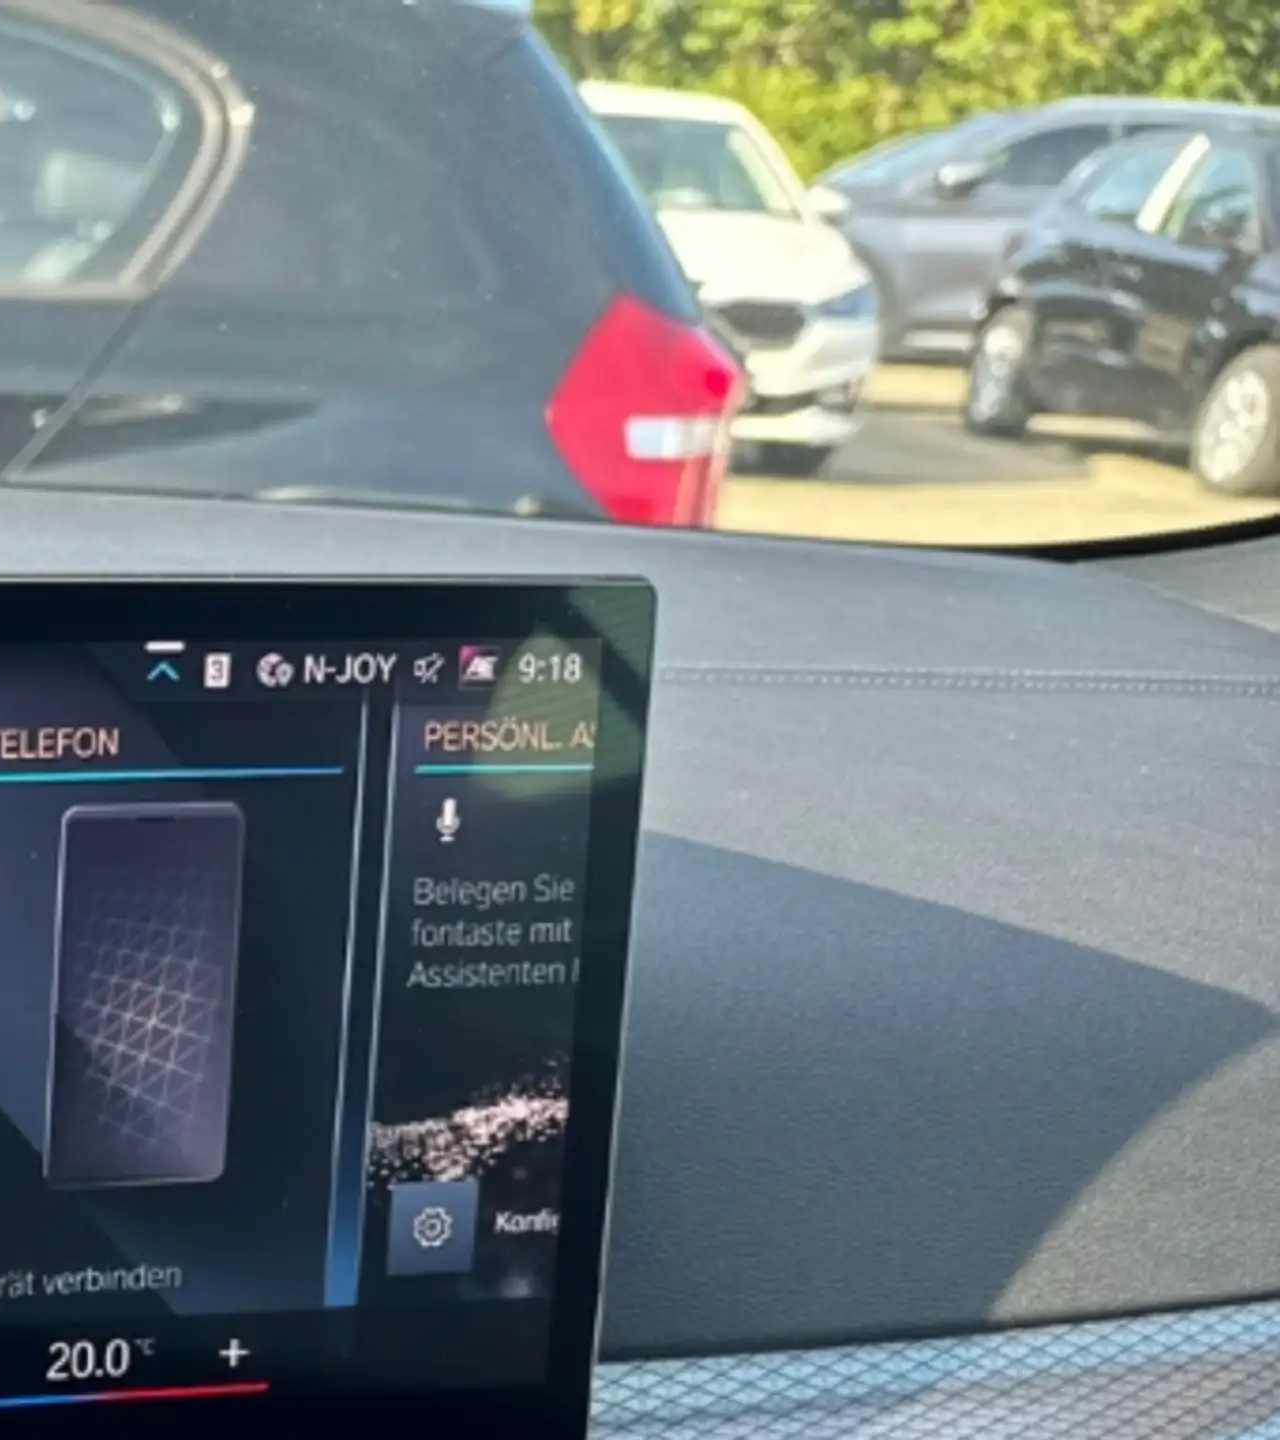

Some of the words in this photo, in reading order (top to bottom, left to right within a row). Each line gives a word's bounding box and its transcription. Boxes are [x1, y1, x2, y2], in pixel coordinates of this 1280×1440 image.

[303, 652, 397, 684] N-JOY
[519, 652, 582, 684] 9:18
[424, 717, 562, 751] PERSÖNL.
[412, 876, 527, 911] Belegen
[534, 873, 576, 902] Sie
[412, 918, 522, 947] fontaste
[530, 917, 573, 944] mit
[406, 959, 566, 988] Assistenten
[43, 1263, 182, 1296] verbinden
[46, 1338, 131, 1381] 20.0
